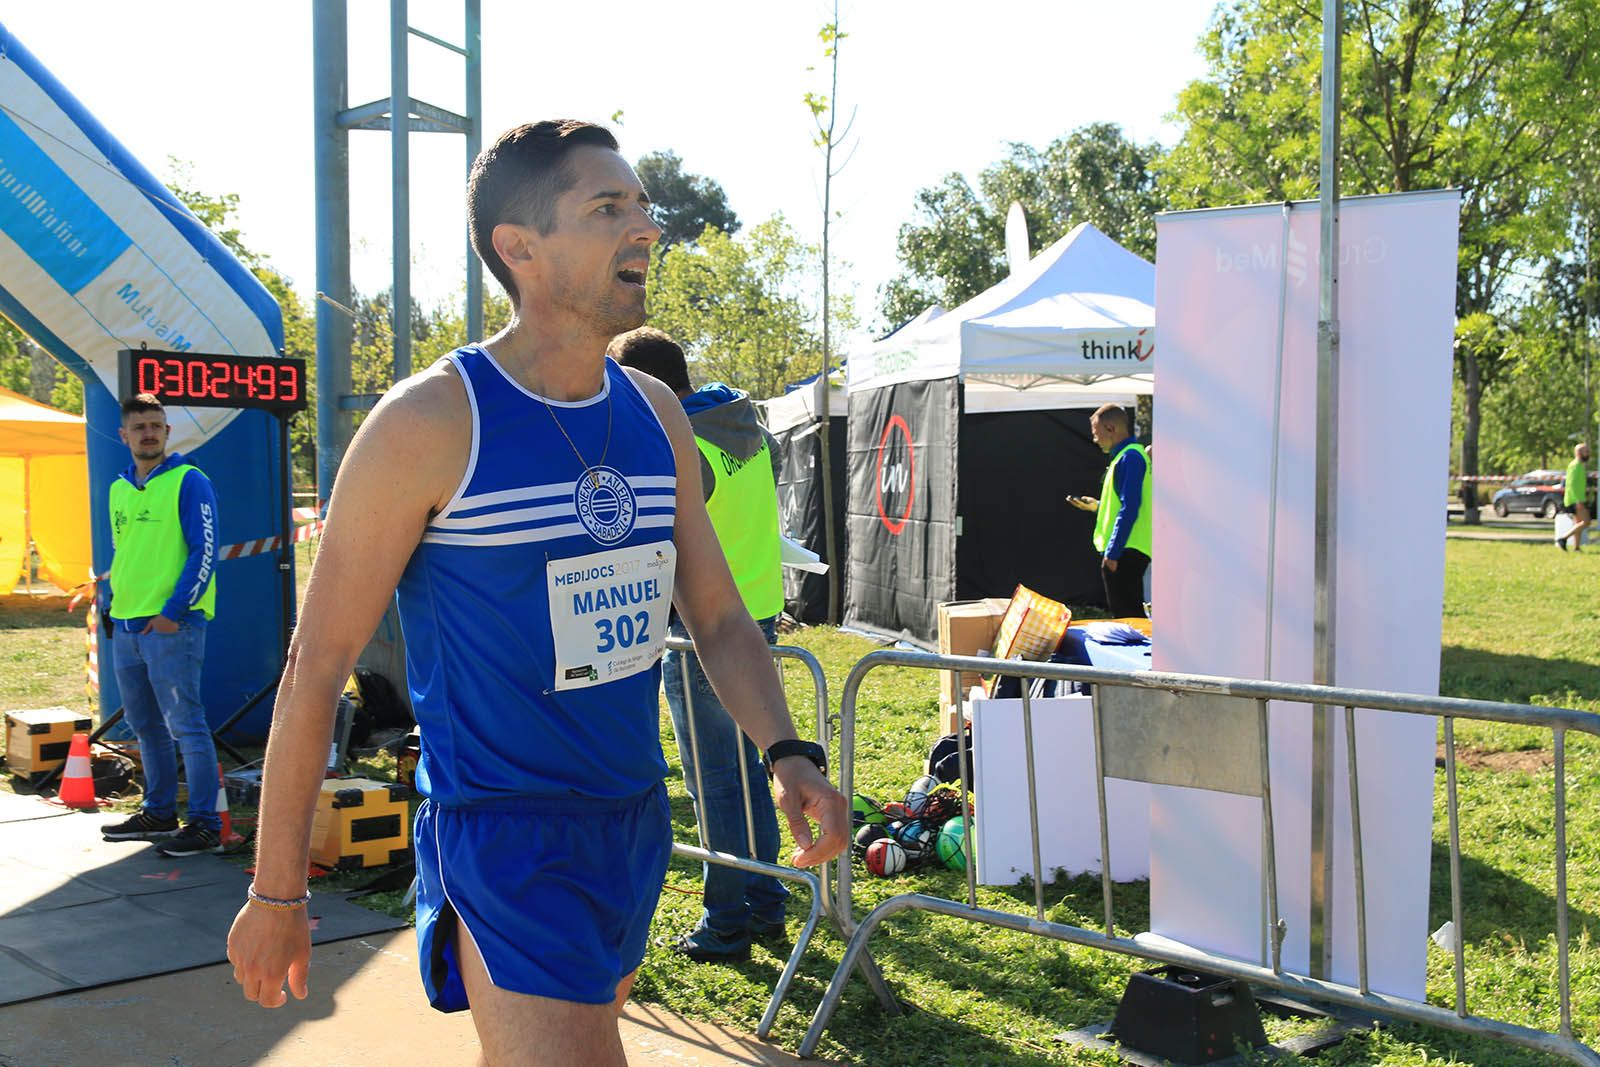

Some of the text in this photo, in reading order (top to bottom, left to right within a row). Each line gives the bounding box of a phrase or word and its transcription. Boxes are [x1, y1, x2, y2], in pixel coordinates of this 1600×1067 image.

[198, 503, 214, 583] BROOKS
[592, 519, 629, 540] SABADELL
[573, 579, 661, 616] MANUEL
[594, 610, 650, 653] 302
